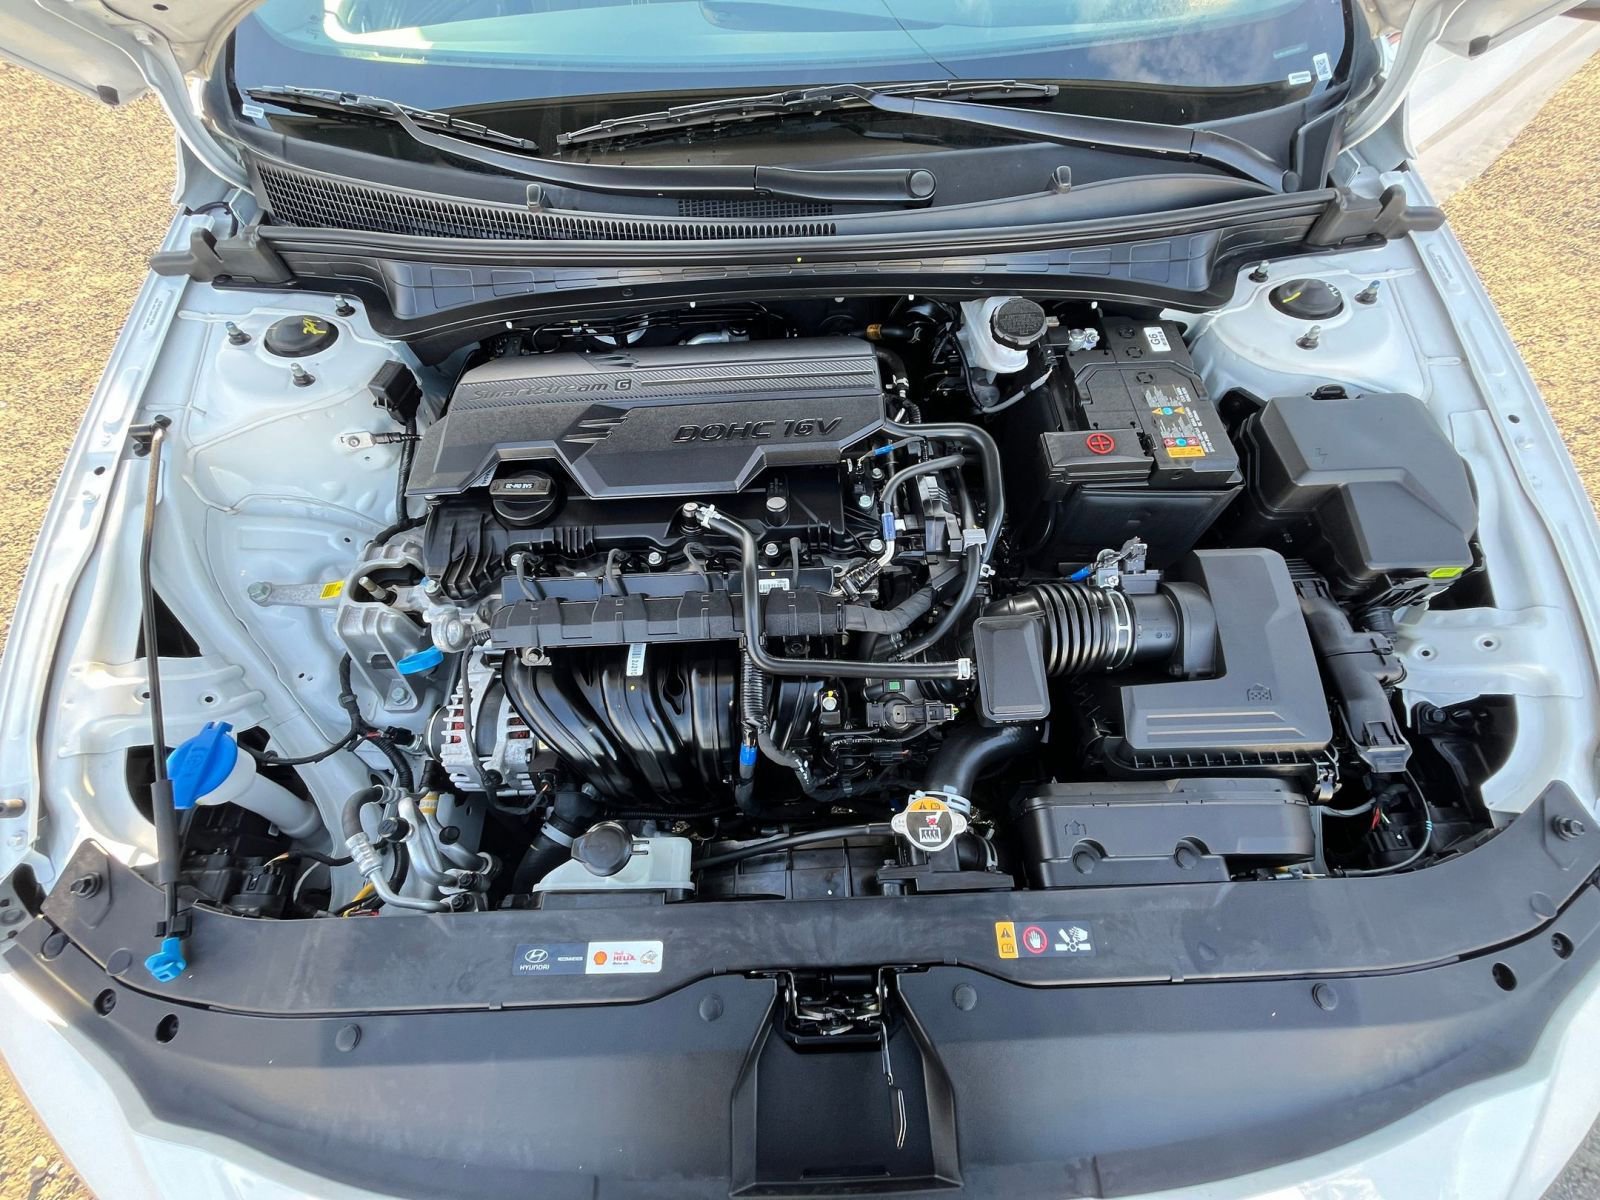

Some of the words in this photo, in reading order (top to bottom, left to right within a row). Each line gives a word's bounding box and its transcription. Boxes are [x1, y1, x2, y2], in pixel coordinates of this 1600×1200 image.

[1149, 334, 1160, 345] G6
[474, 382, 608, 401] Smartstream
[672, 420, 776, 443] DOHC
[783, 416, 843, 438] 16V
[519, 963, 550, 971] HYUNDAI
